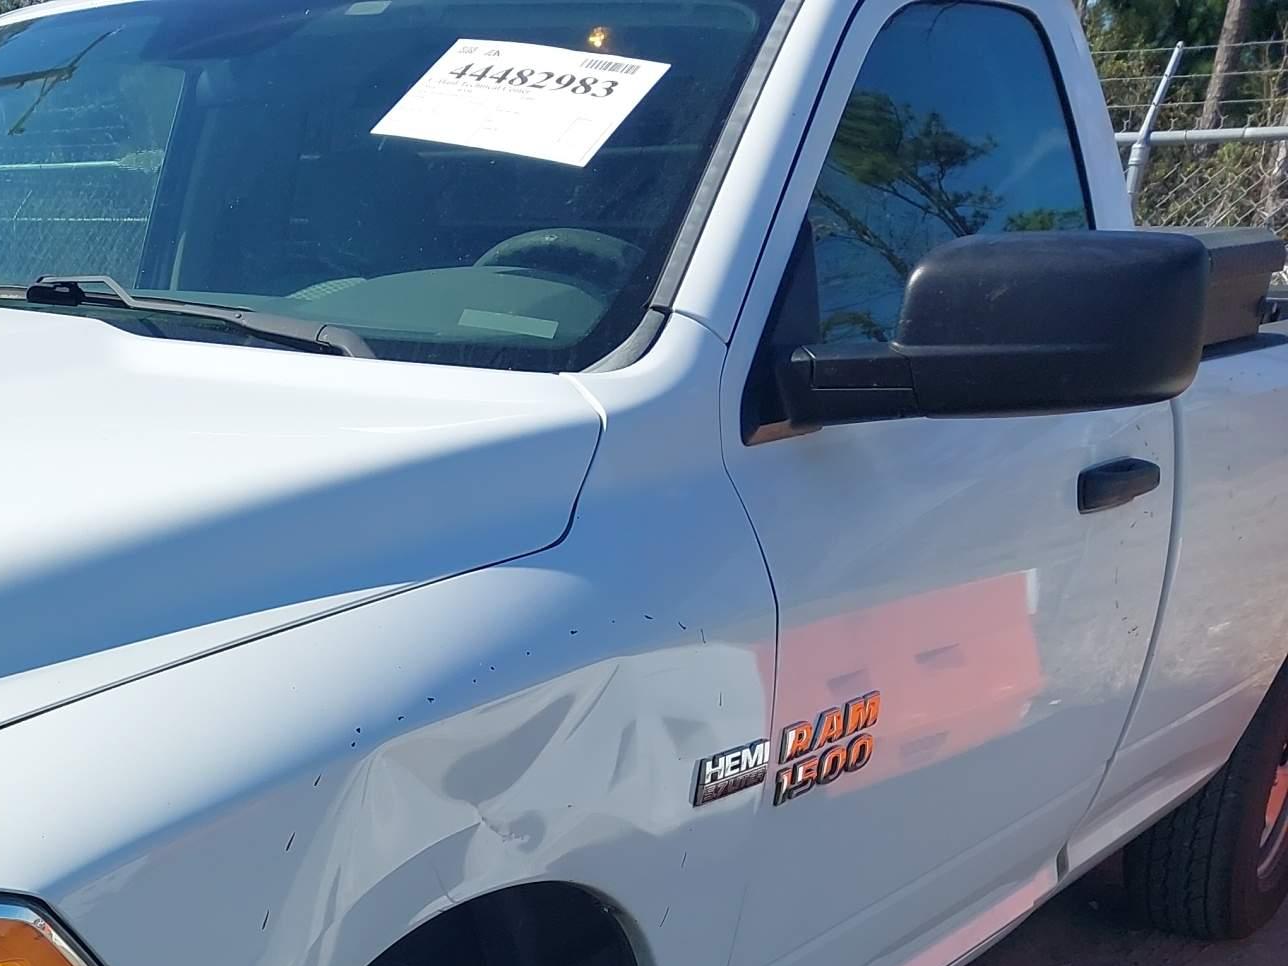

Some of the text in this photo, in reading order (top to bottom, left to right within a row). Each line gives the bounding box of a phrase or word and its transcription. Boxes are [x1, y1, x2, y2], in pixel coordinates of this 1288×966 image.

[448, 61, 620, 98] 44482983
[778, 690, 880, 765] RAM
[704, 740, 770, 785] HEMI
[772, 733, 873, 807] 1500
